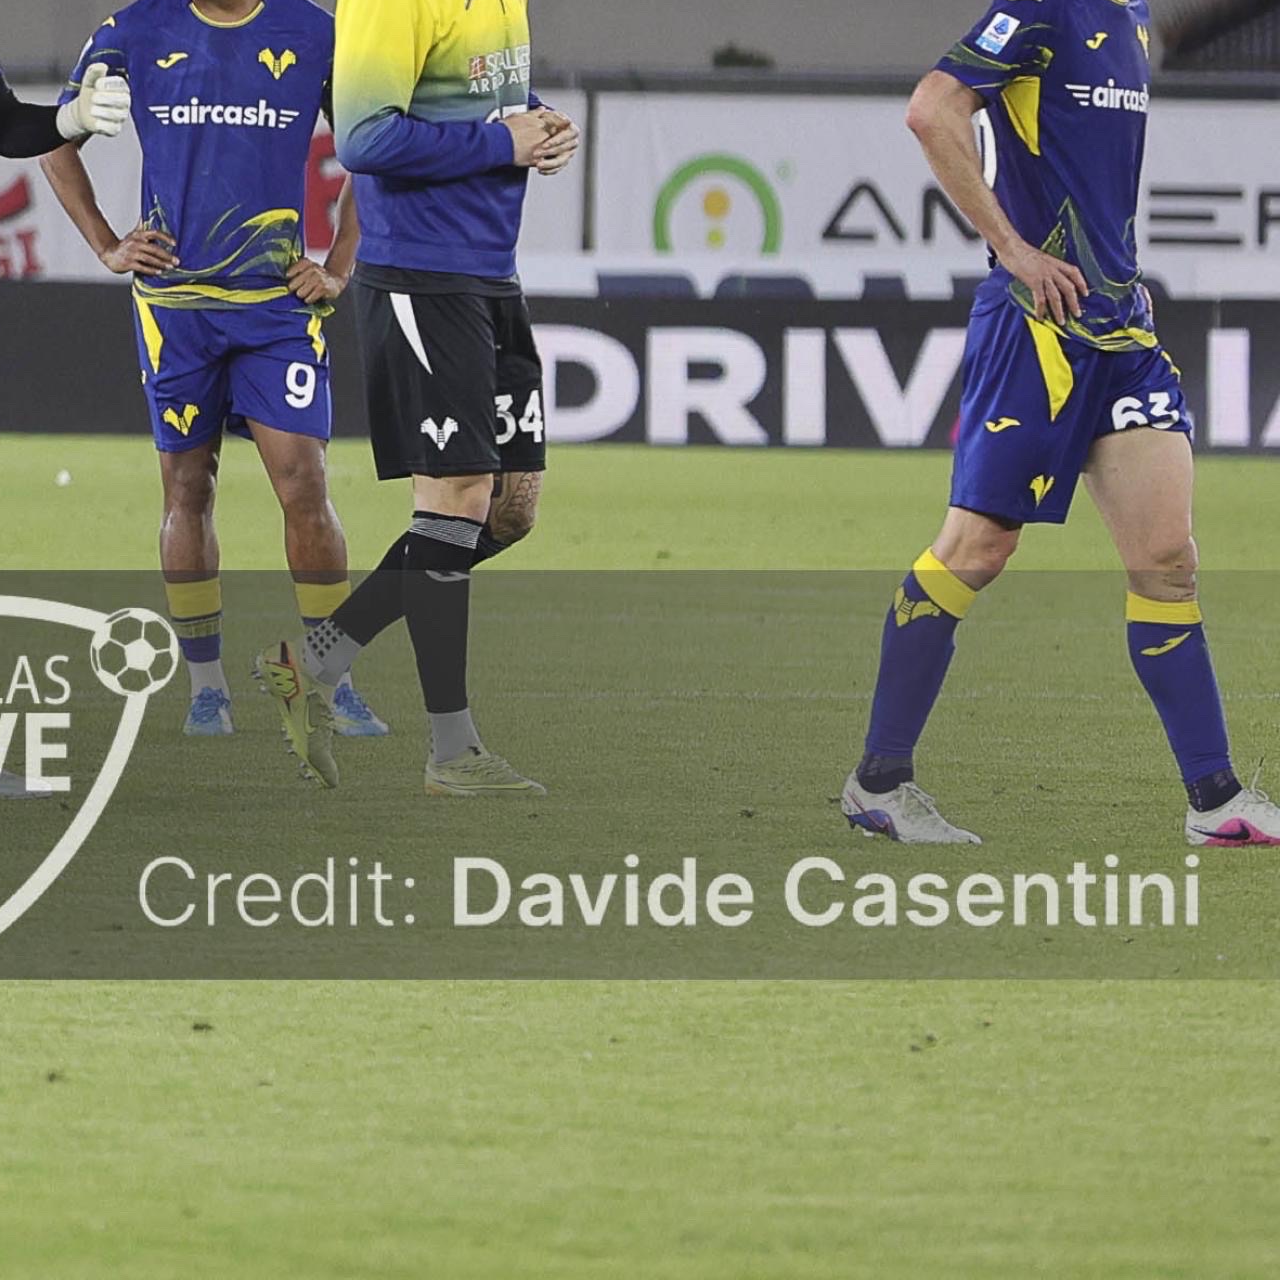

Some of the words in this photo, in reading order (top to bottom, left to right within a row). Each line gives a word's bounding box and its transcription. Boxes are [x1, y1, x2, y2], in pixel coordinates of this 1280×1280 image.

[171, 98, 277, 128] aircash
[286, 362, 316, 409] 9
[495, 389, 543, 445] 34
[1112, 392, 1180, 430] 63
